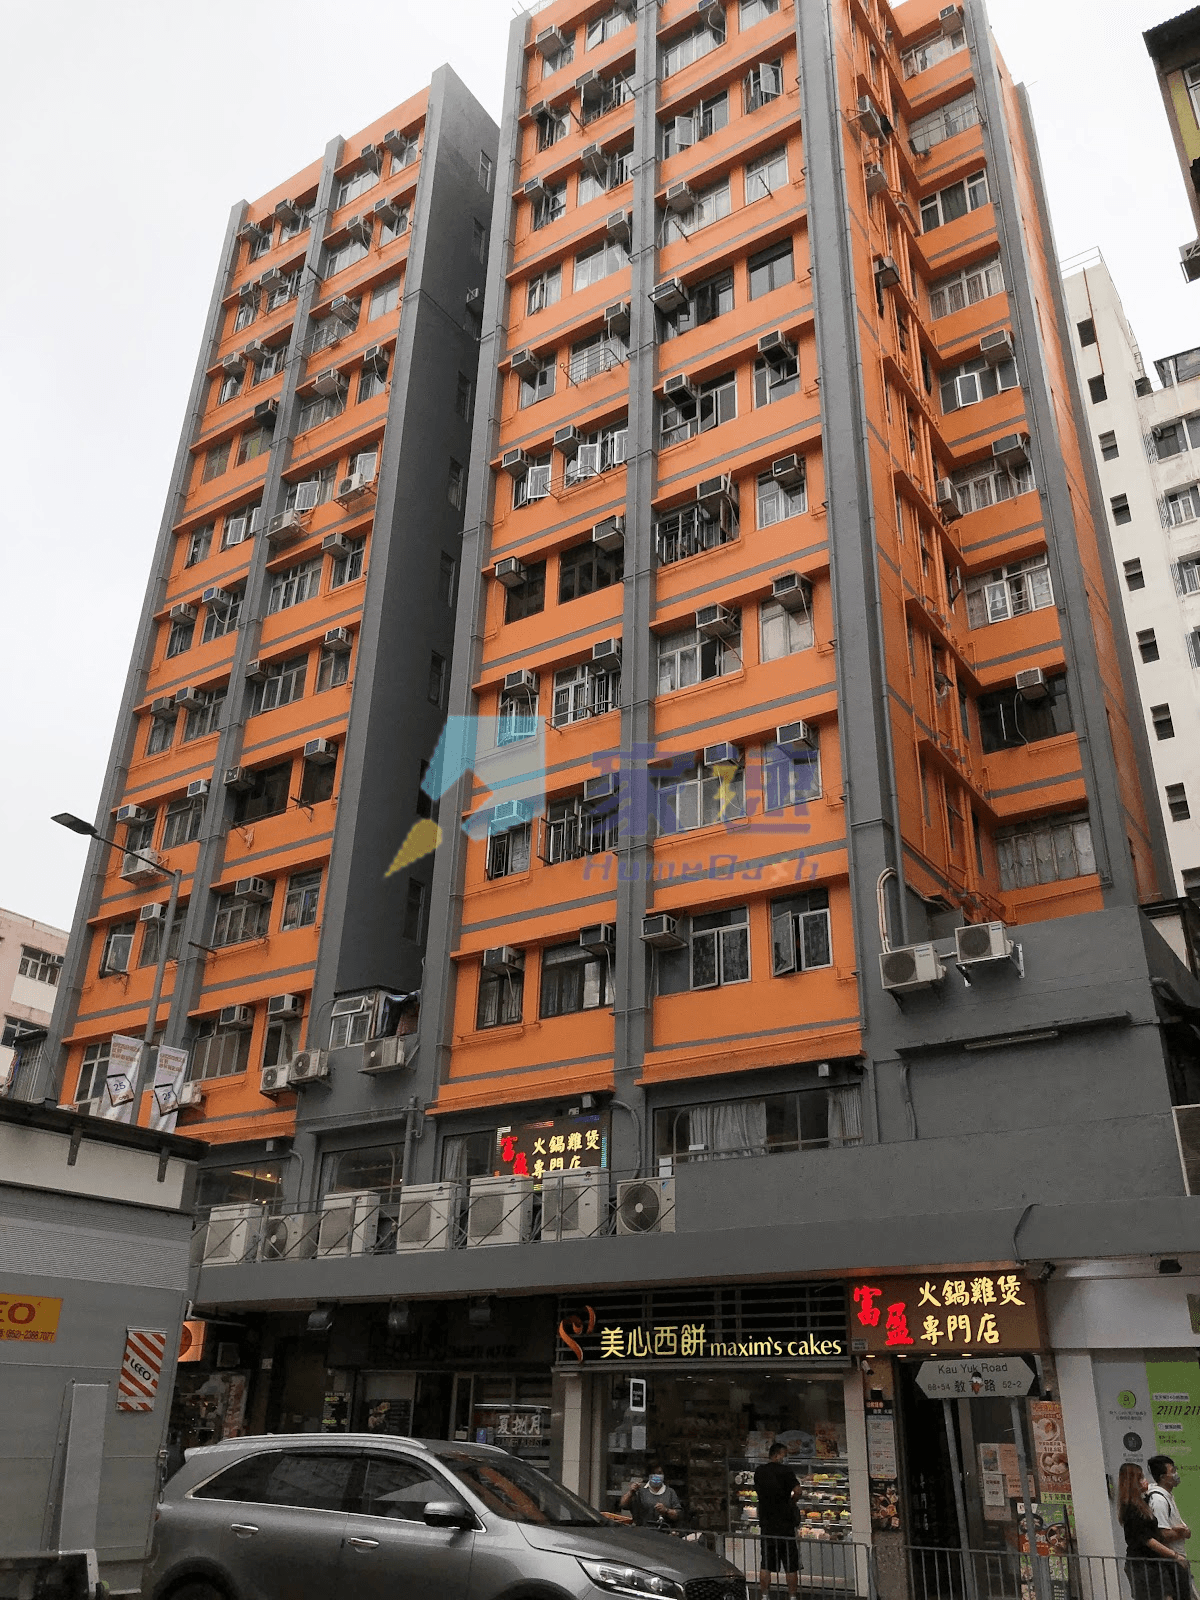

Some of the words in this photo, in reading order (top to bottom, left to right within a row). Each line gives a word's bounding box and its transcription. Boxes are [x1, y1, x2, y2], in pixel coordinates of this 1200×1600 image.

[113, 1081, 126, 1091] 25
[917, 1275, 1026, 1307] 火鍋雞煲
[600, 1324, 707, 1358] 美心西餅
[711, 1335, 783, 1357] maxim's
[787, 1333, 842, 1356] cakes
[130, 1358, 152, 1381] LEEO
[938, 1364, 957, 1375] Kau
[961, 1363, 978, 1373] Yuk
[981, 1362, 1008, 1373] Road
[954, 1379, 996, 1393] 教路
[1003, 1380, 1022, 1389] 52-2
